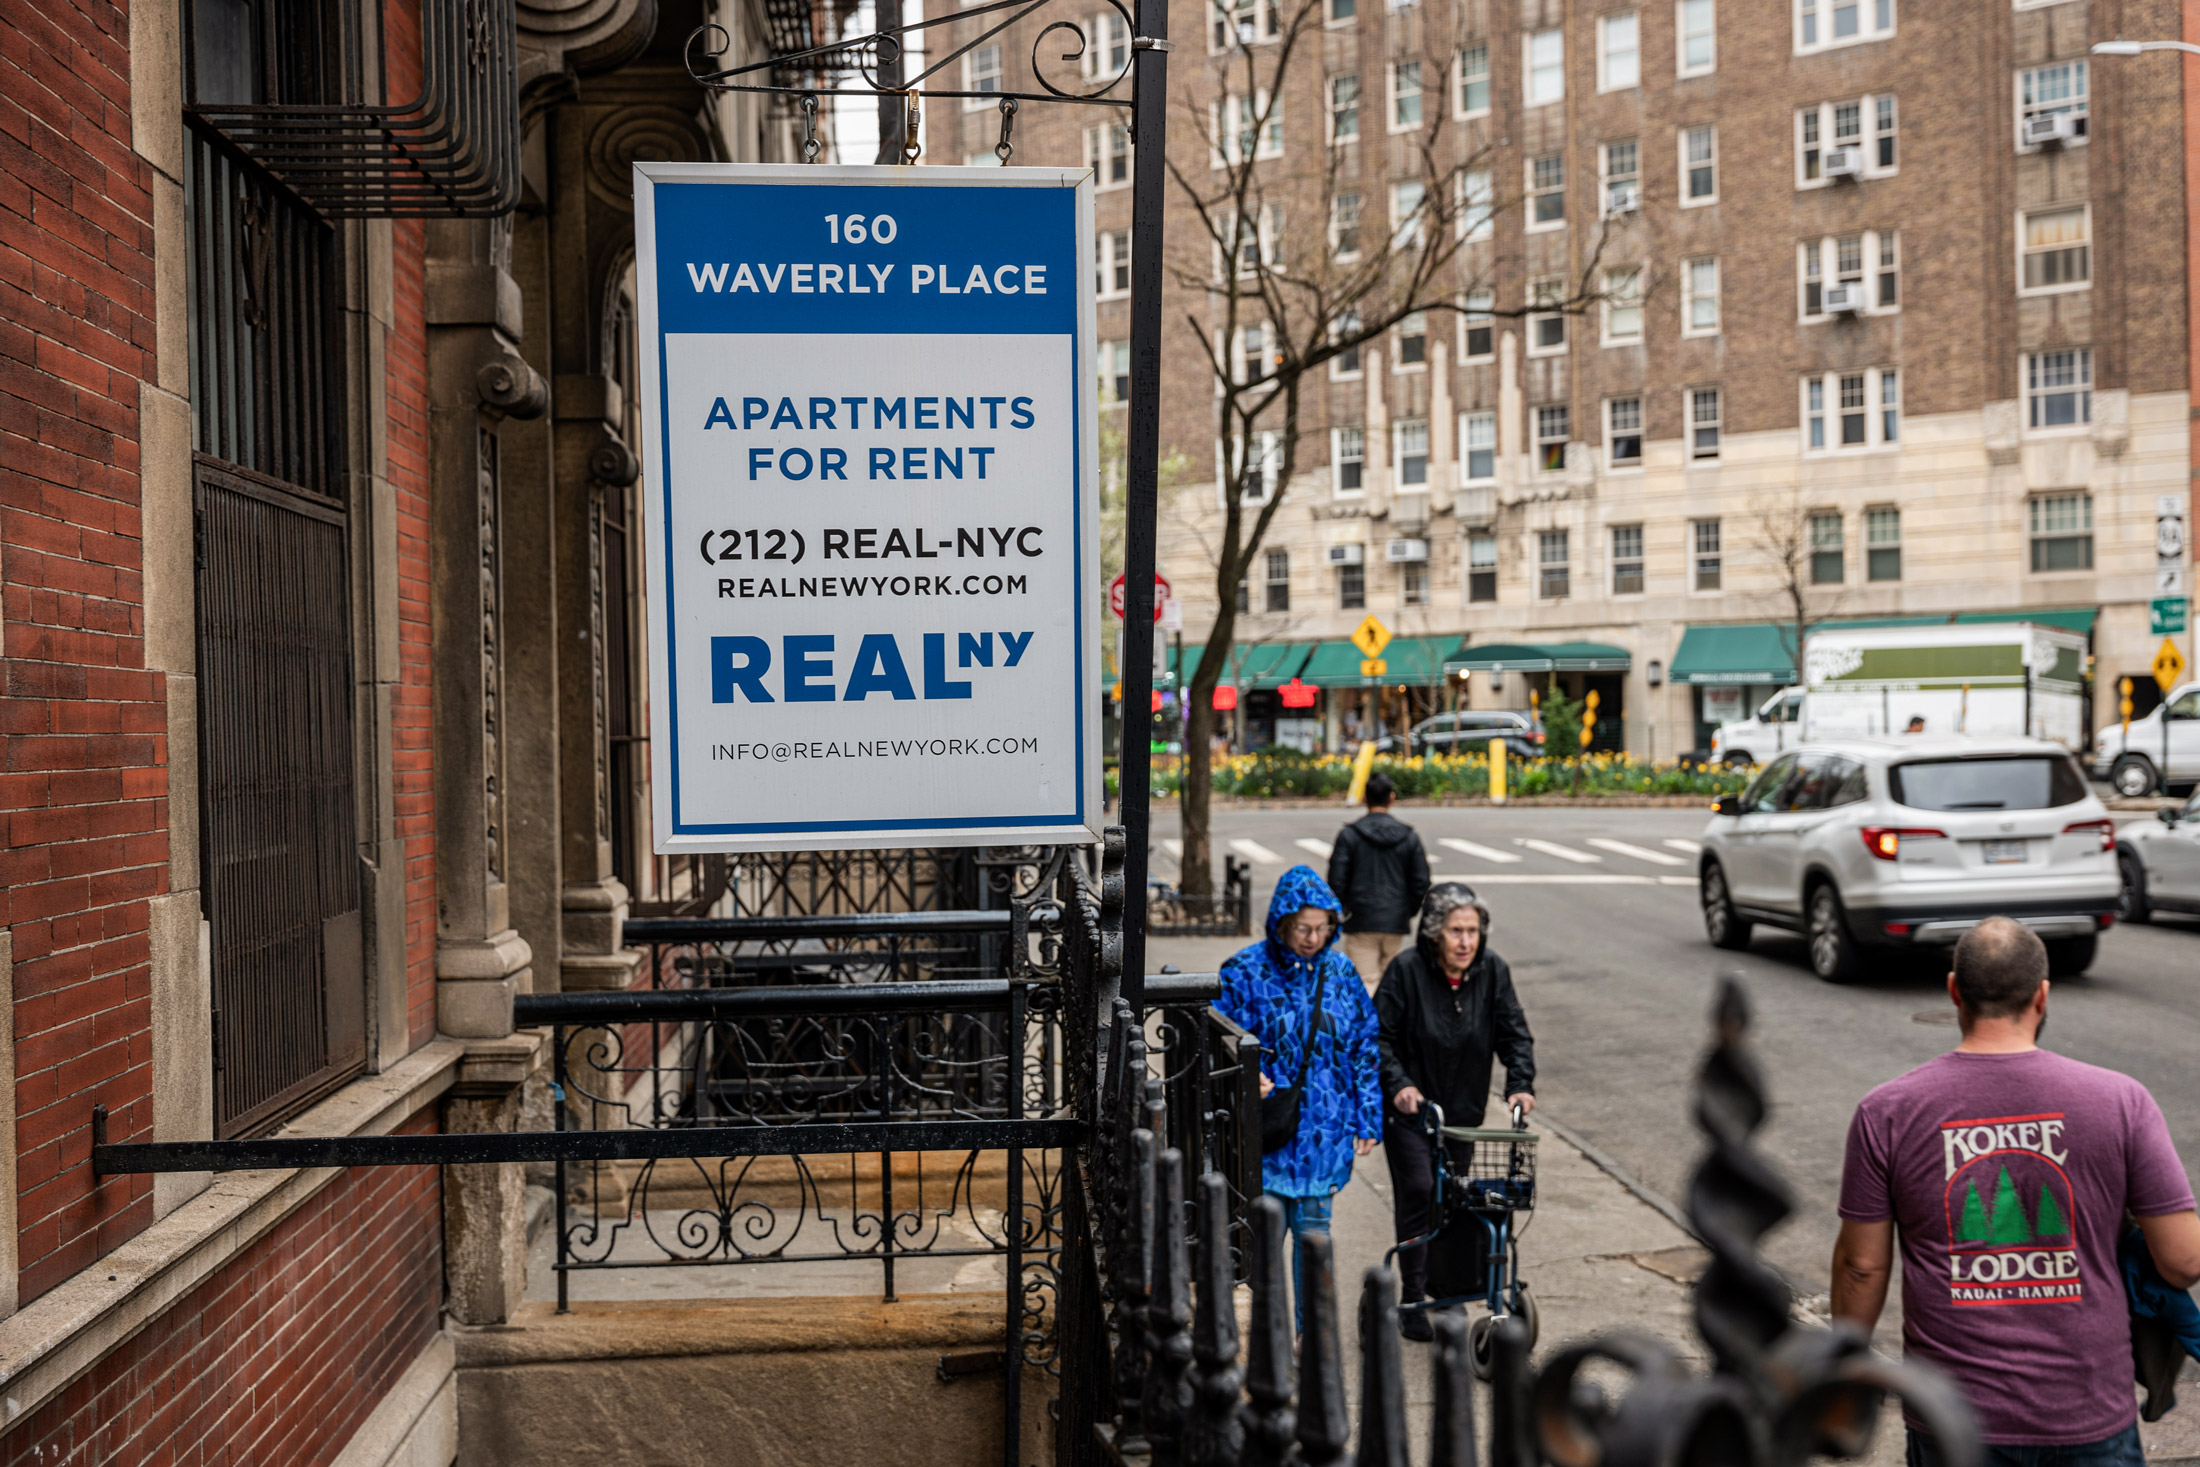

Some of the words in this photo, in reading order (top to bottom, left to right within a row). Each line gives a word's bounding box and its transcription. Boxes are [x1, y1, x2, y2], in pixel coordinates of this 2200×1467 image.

[825, 213, 898, 245] 160
[686, 262, 895, 294] WAVERLY
[911, 264, 1048, 295] PLACE
[703, 396, 1036, 430] APARTMENTS
[748, 447, 848, 481] FOR
[868, 446, 996, 480] RENT
[700, 528, 806, 566] (212)
[823, 526, 1044, 560] REAL-NYC
[718, 574, 1028, 599] REALNEWYORK.COM
[1113, 583, 1168, 611] SP
[711, 736, 1039, 763] INFO@REALNEWYORK.COM
[1941, 1119, 2069, 1181] KOKEE
[1949, 1250, 2080, 1284] LODGE
[1951, 1285, 2003, 1300] KAUAI
[2018, 1283, 2082, 1300] HAWAII
